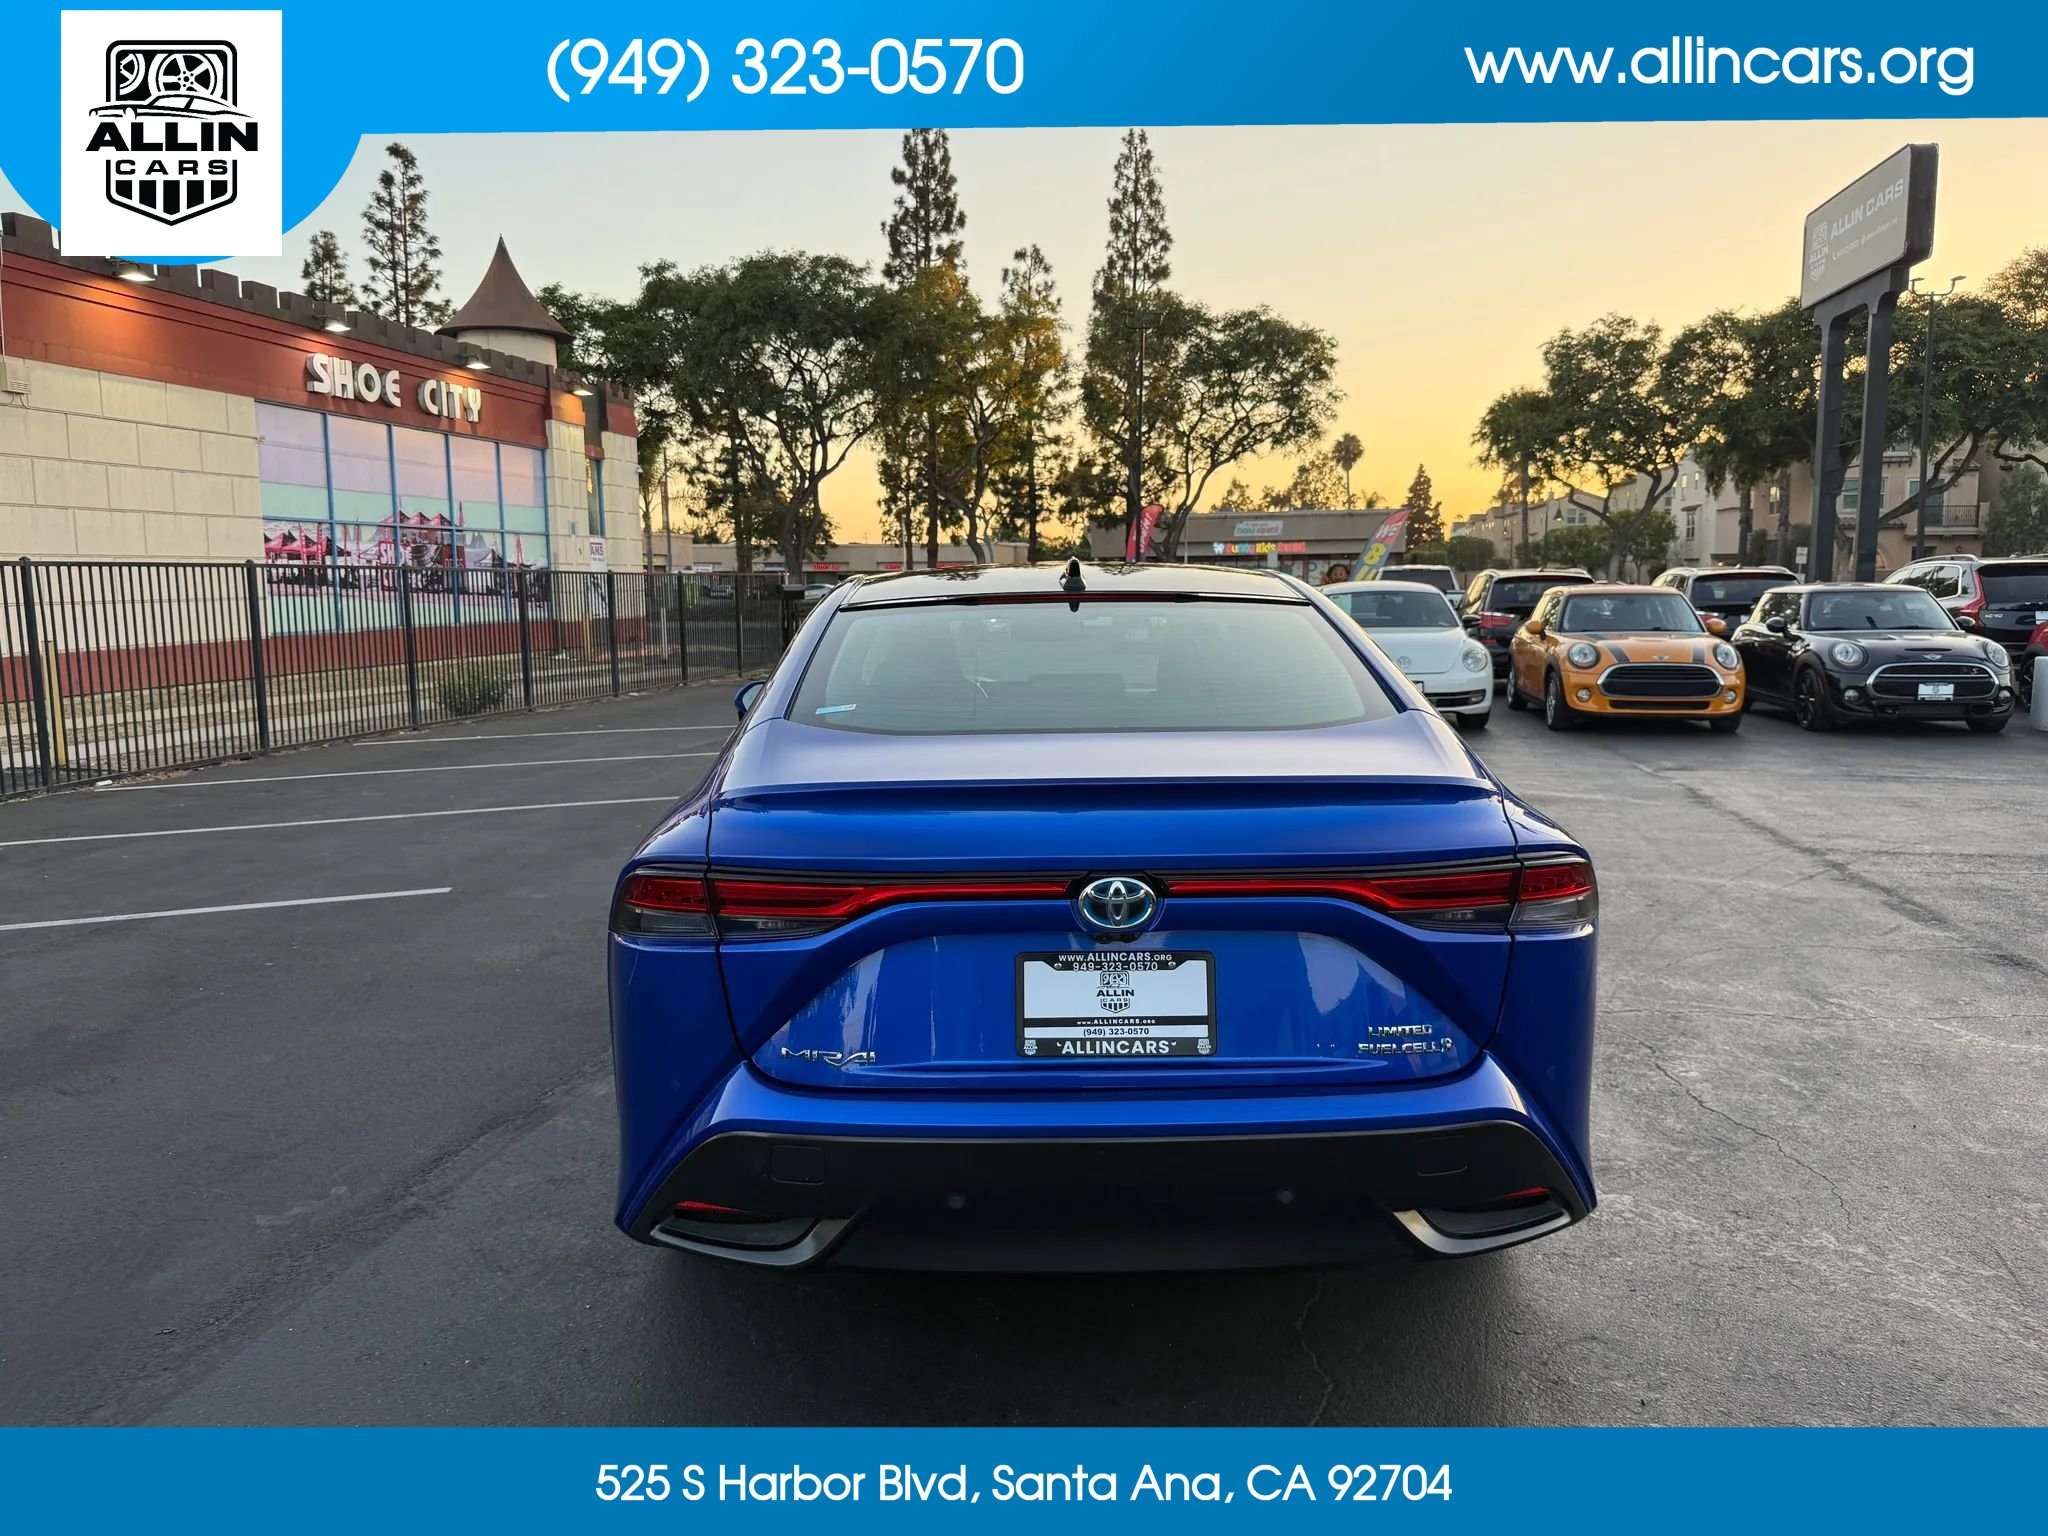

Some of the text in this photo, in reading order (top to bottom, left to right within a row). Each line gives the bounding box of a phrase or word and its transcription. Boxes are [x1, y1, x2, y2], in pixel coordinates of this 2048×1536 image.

[1831, 204, 1863, 240] ALLIN
[1866, 178, 1904, 217] CARS
[306, 352, 481, 422] SHOE CITY
[590, 542, 605, 556] ANS
[1072, 961, 1158, 972] 949-323-0570
[1096, 988, 1135, 997] ALLIN
[1083, 1026, 1150, 1037] (949) 323-0570
[1367, 1024, 1433, 1037] LIMITED
